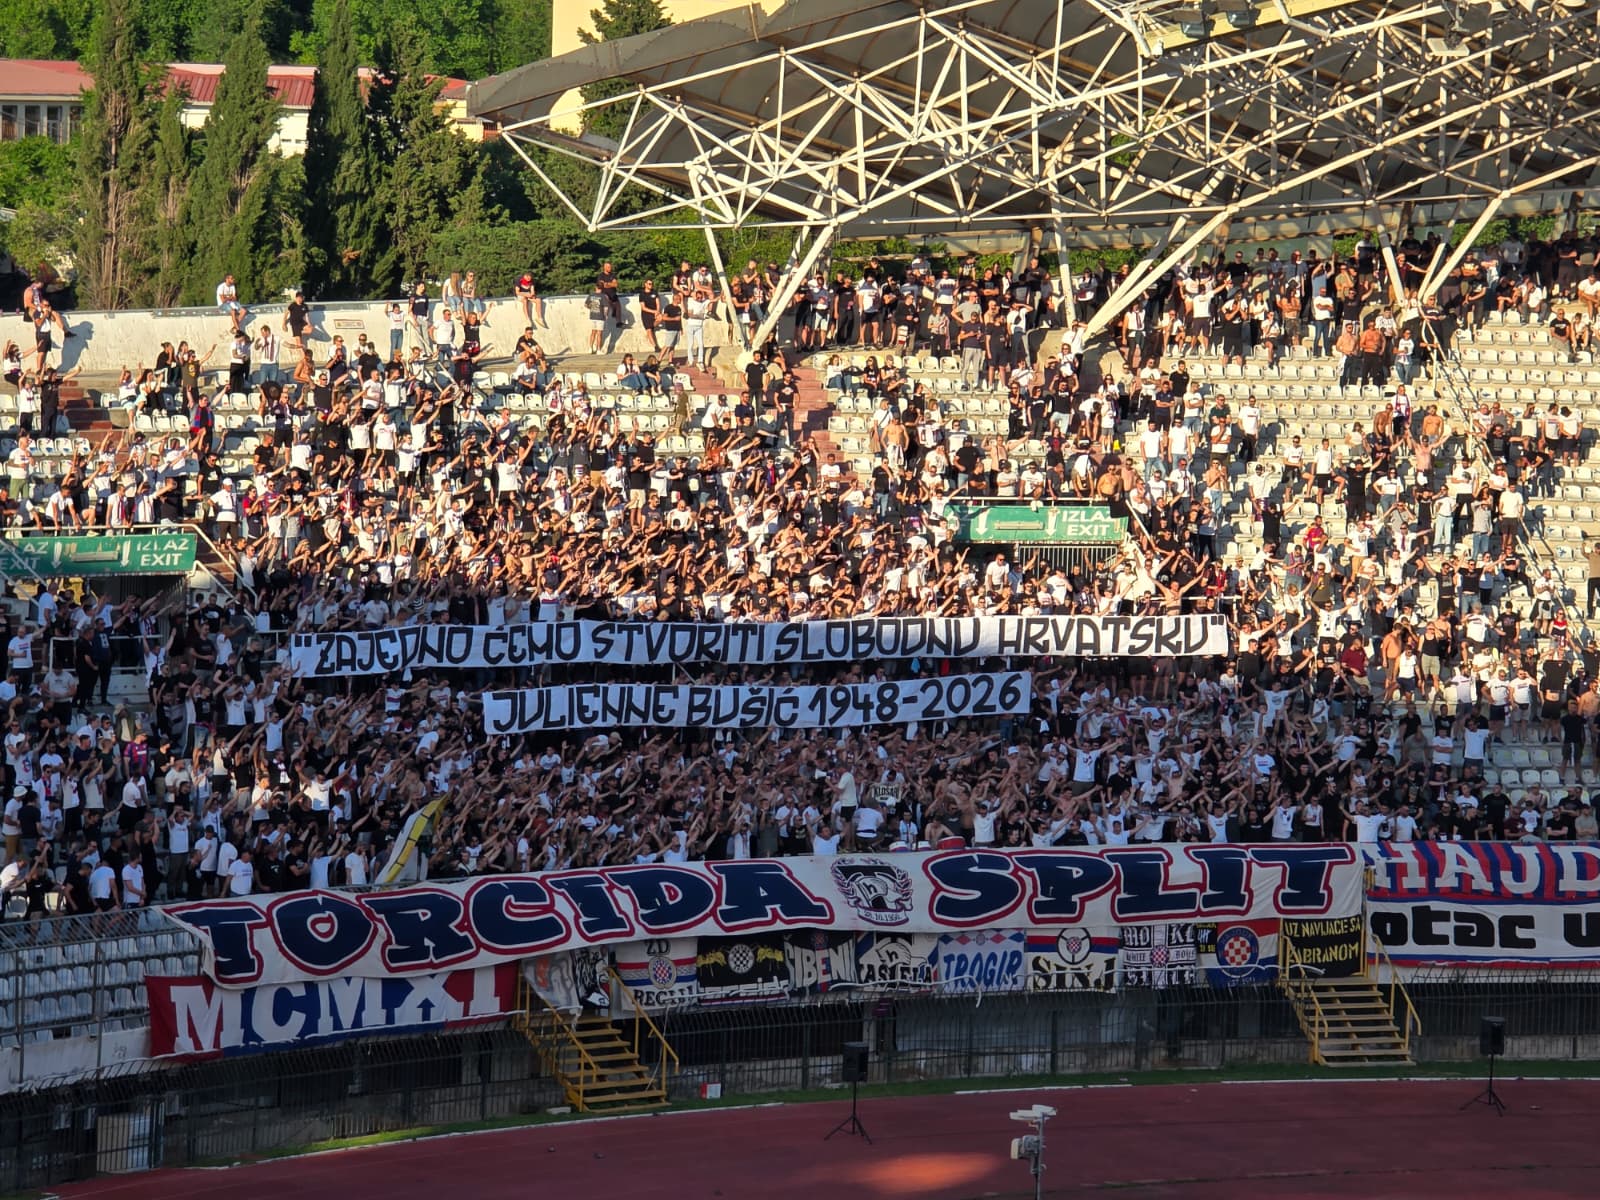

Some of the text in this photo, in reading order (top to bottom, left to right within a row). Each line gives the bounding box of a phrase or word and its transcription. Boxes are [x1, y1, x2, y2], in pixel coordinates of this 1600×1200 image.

[1067, 524, 1110, 536] EXIT
[141, 553, 183, 567] EXIT
[592, 620, 764, 664] STVORITI
[775, 617, 981, 661] SLOBODNU
[492, 672, 1023, 732] JULIENNE BUŠIĆ 1948-2026
[1360, 842, 1600, 894] HAJD
[161, 842, 1356, 985] TORCIDA SPLIT
[1285, 921, 1300, 937] UZ
[1370, 905, 1537, 949] otac
[943, 950, 1023, 988] TROGIR
[1032, 956, 1116, 990] SINJ
[170, 964, 501, 1053] MCMXI
